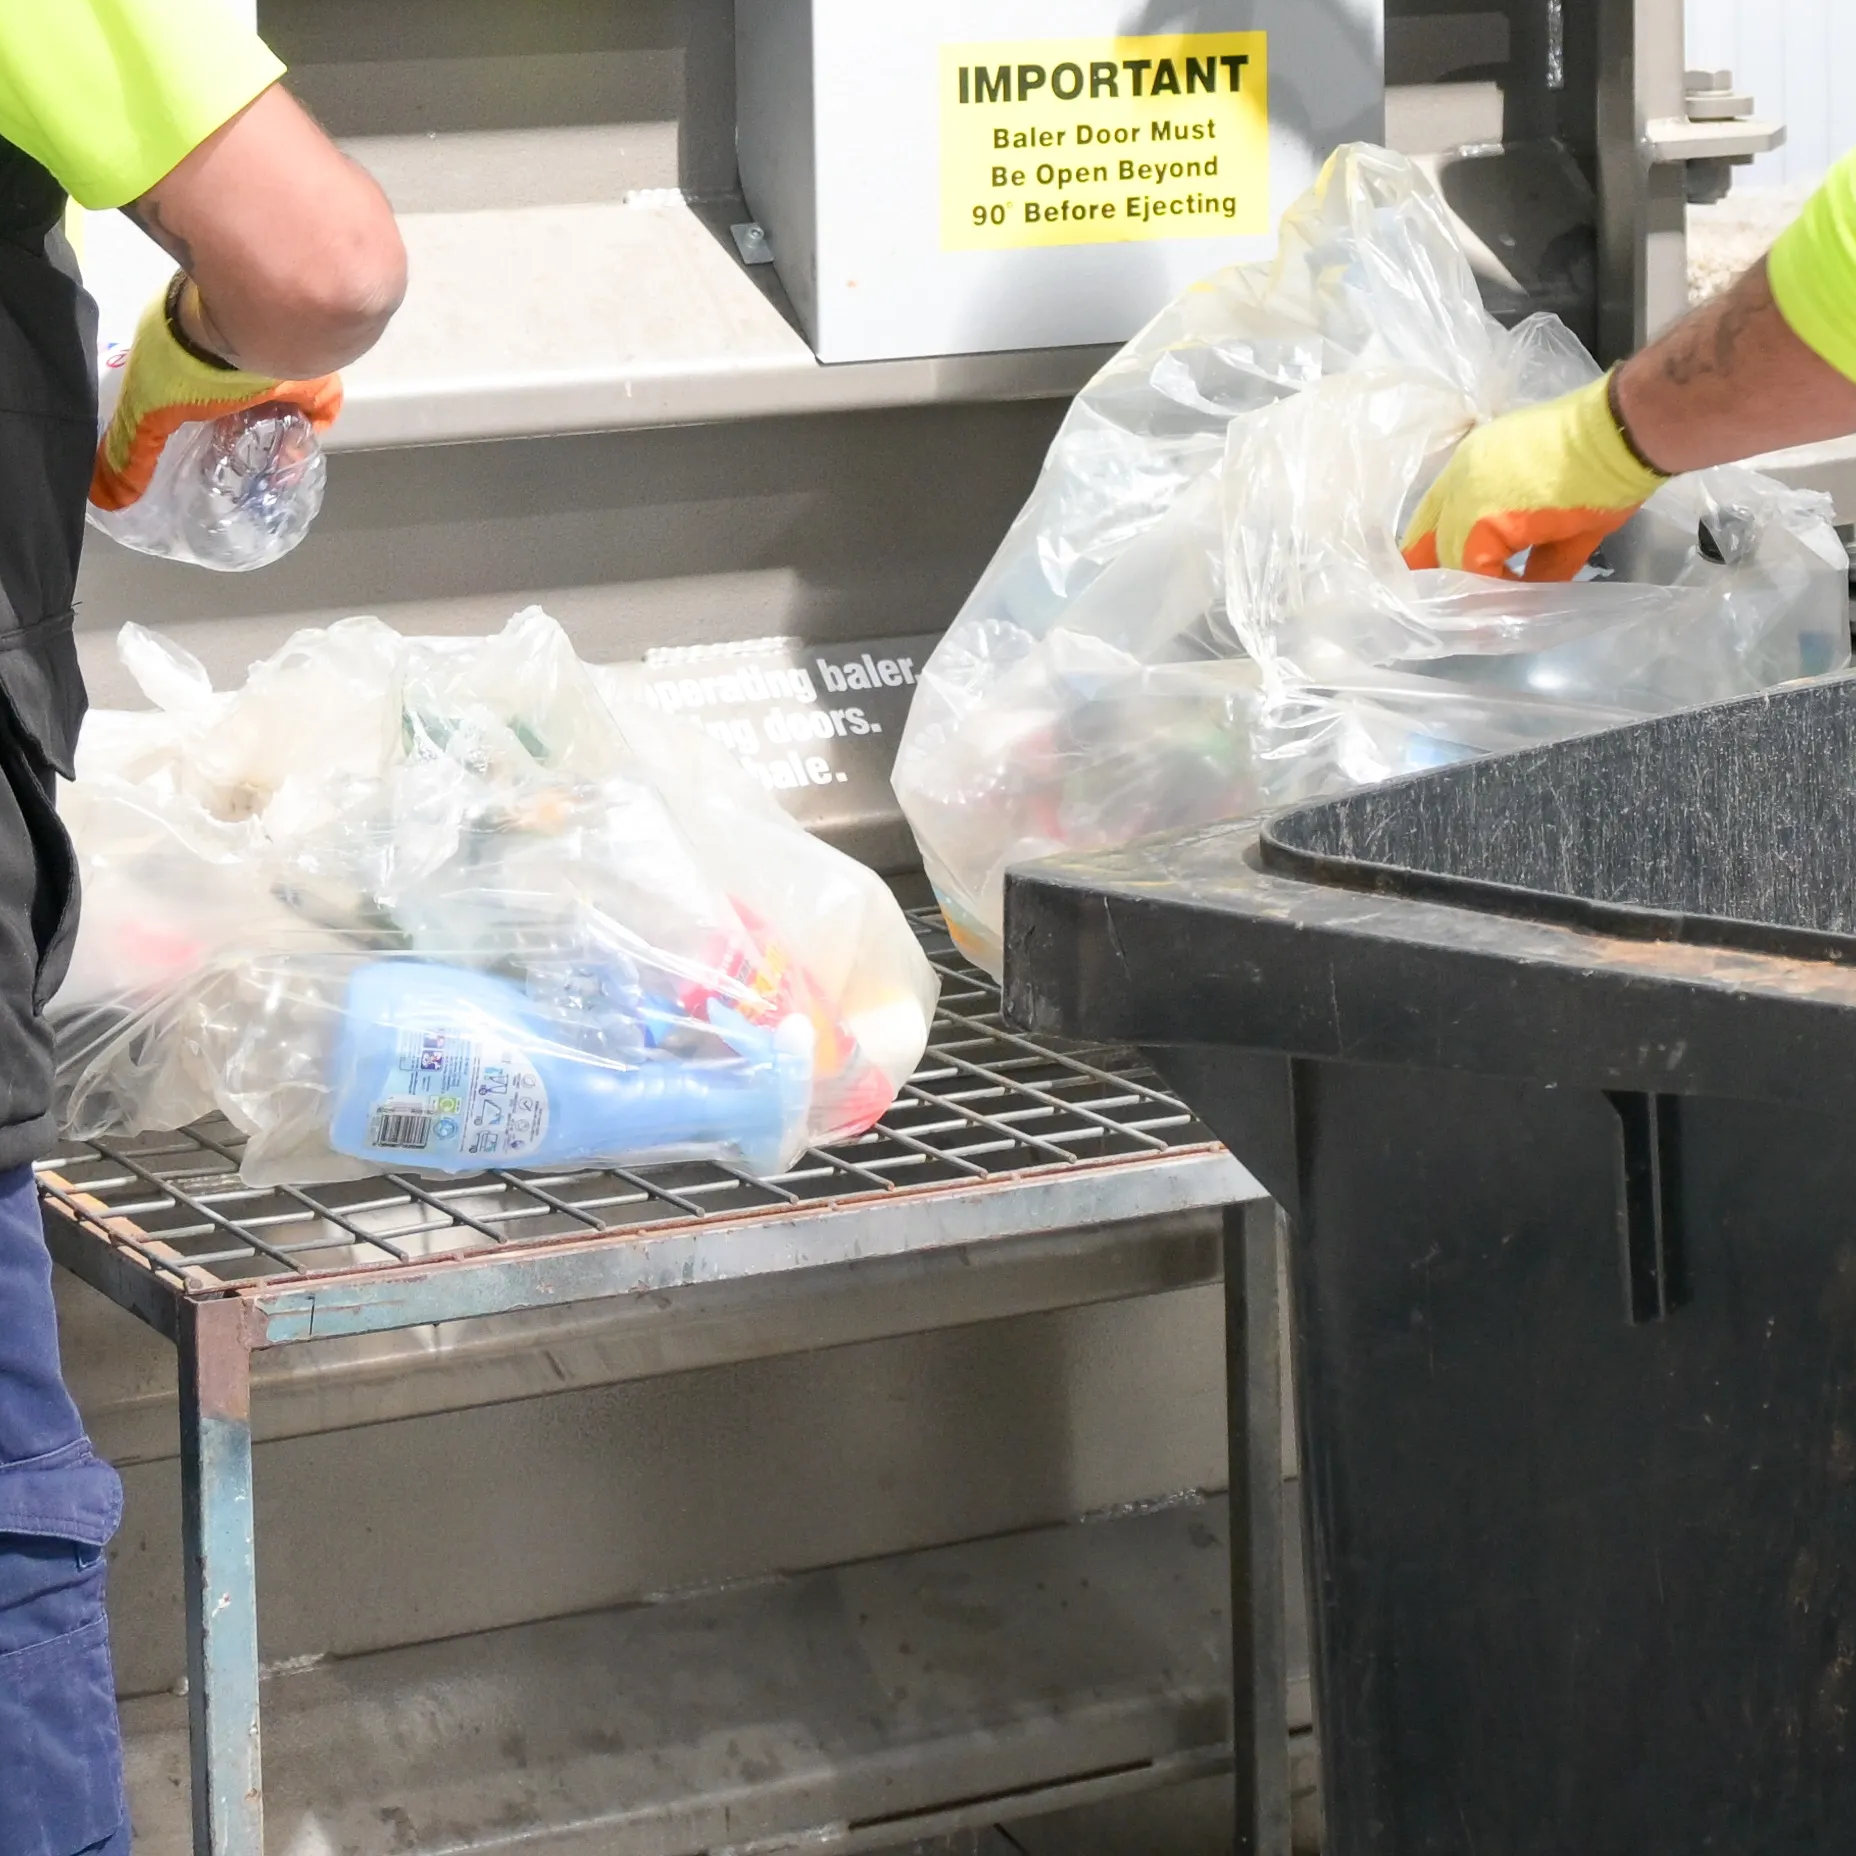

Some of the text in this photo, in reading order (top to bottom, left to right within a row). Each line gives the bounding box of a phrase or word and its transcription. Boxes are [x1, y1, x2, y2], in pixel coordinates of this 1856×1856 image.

[958, 55, 1249, 104] IMPORTANT
[993, 119, 1216, 149] Baler Door Must
[991, 156, 1219, 190] Be Open Beyond
[1024, 197, 1116, 224] Before
[1126, 192, 1237, 222] Ejecting
[763, 706, 882, 744] doors.
